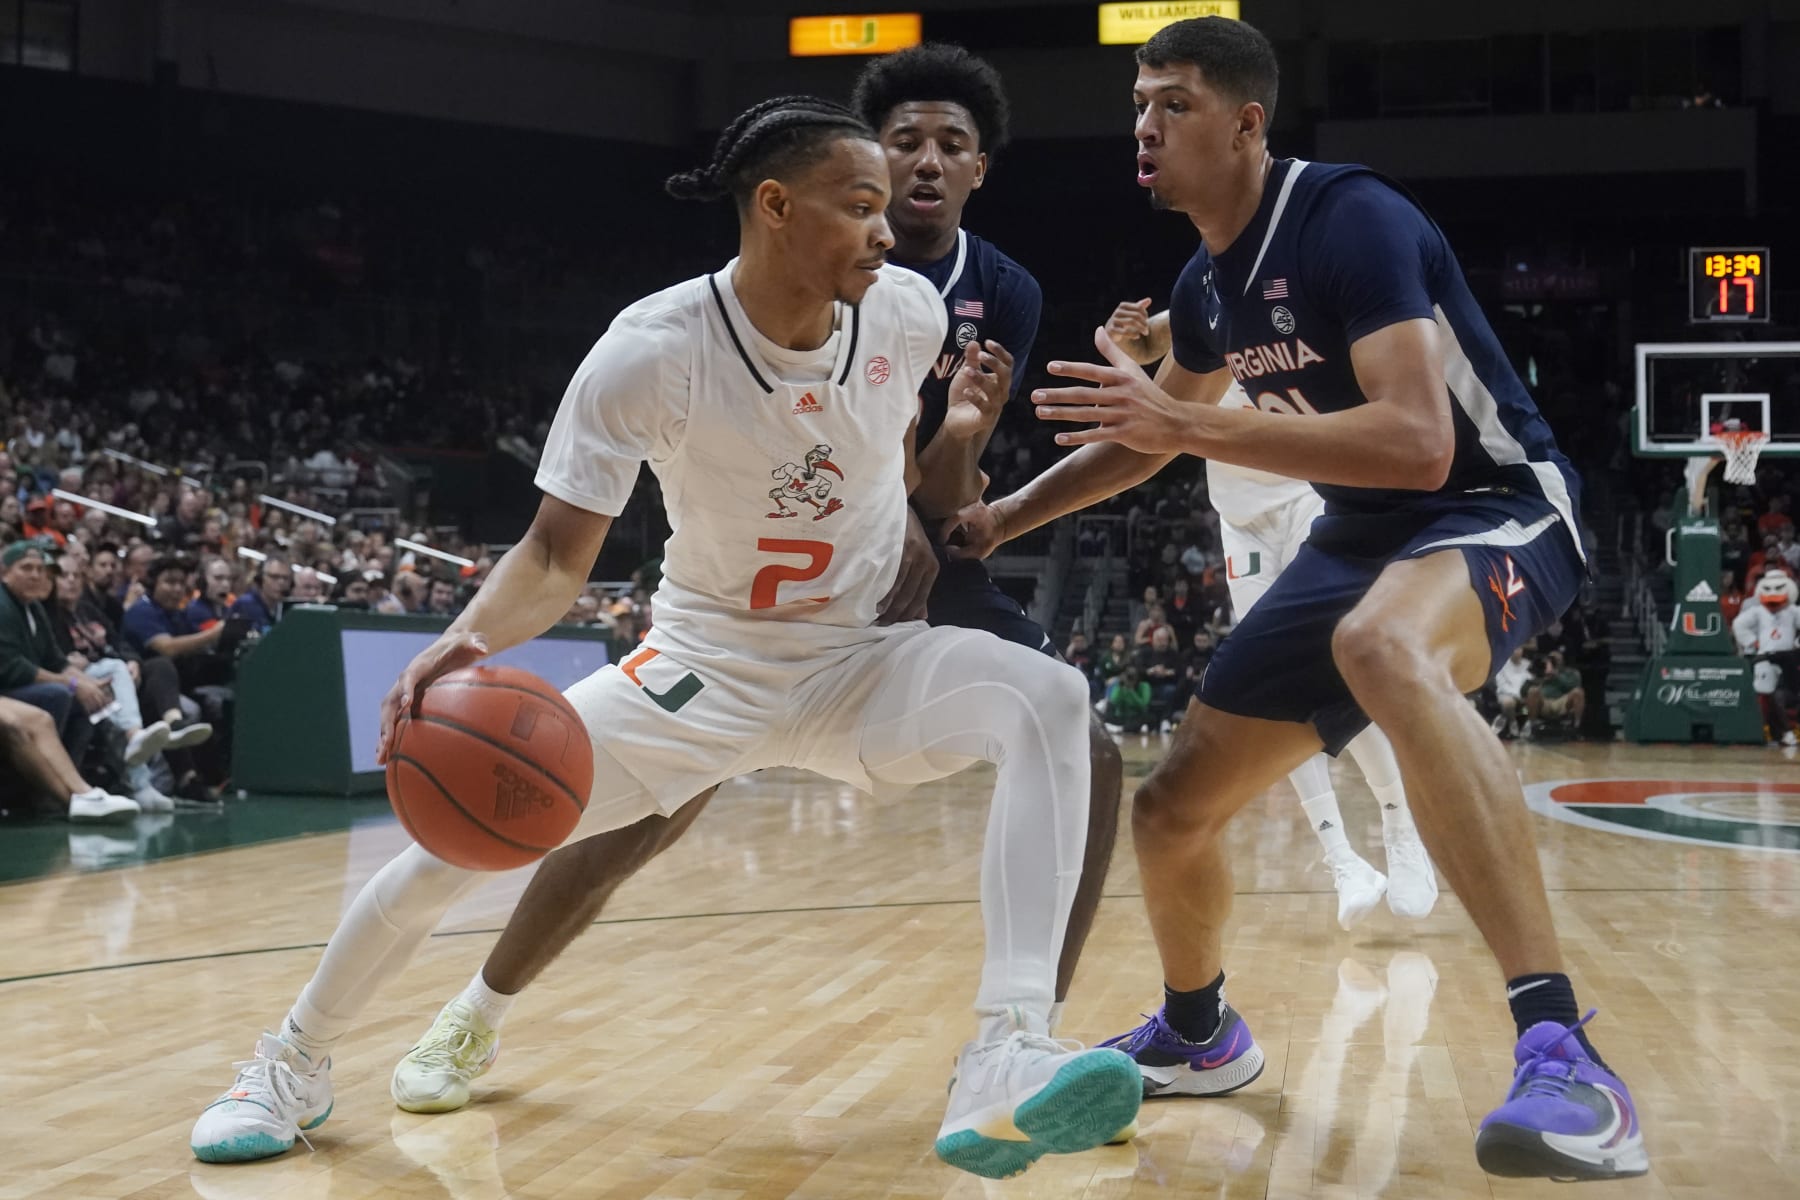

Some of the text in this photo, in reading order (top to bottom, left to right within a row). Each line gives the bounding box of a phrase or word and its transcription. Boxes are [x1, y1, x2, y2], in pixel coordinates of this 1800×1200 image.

[1119, 5, 1221, 19] WILLIAMSON
[1705, 254, 1760, 277] 13:39
[1720, 277, 1754, 313] 17
[792, 405, 823, 415] adidas
[750, 537, 834, 609] 2
[1683, 613, 1721, 636] U
[621, 647, 705, 713] U
